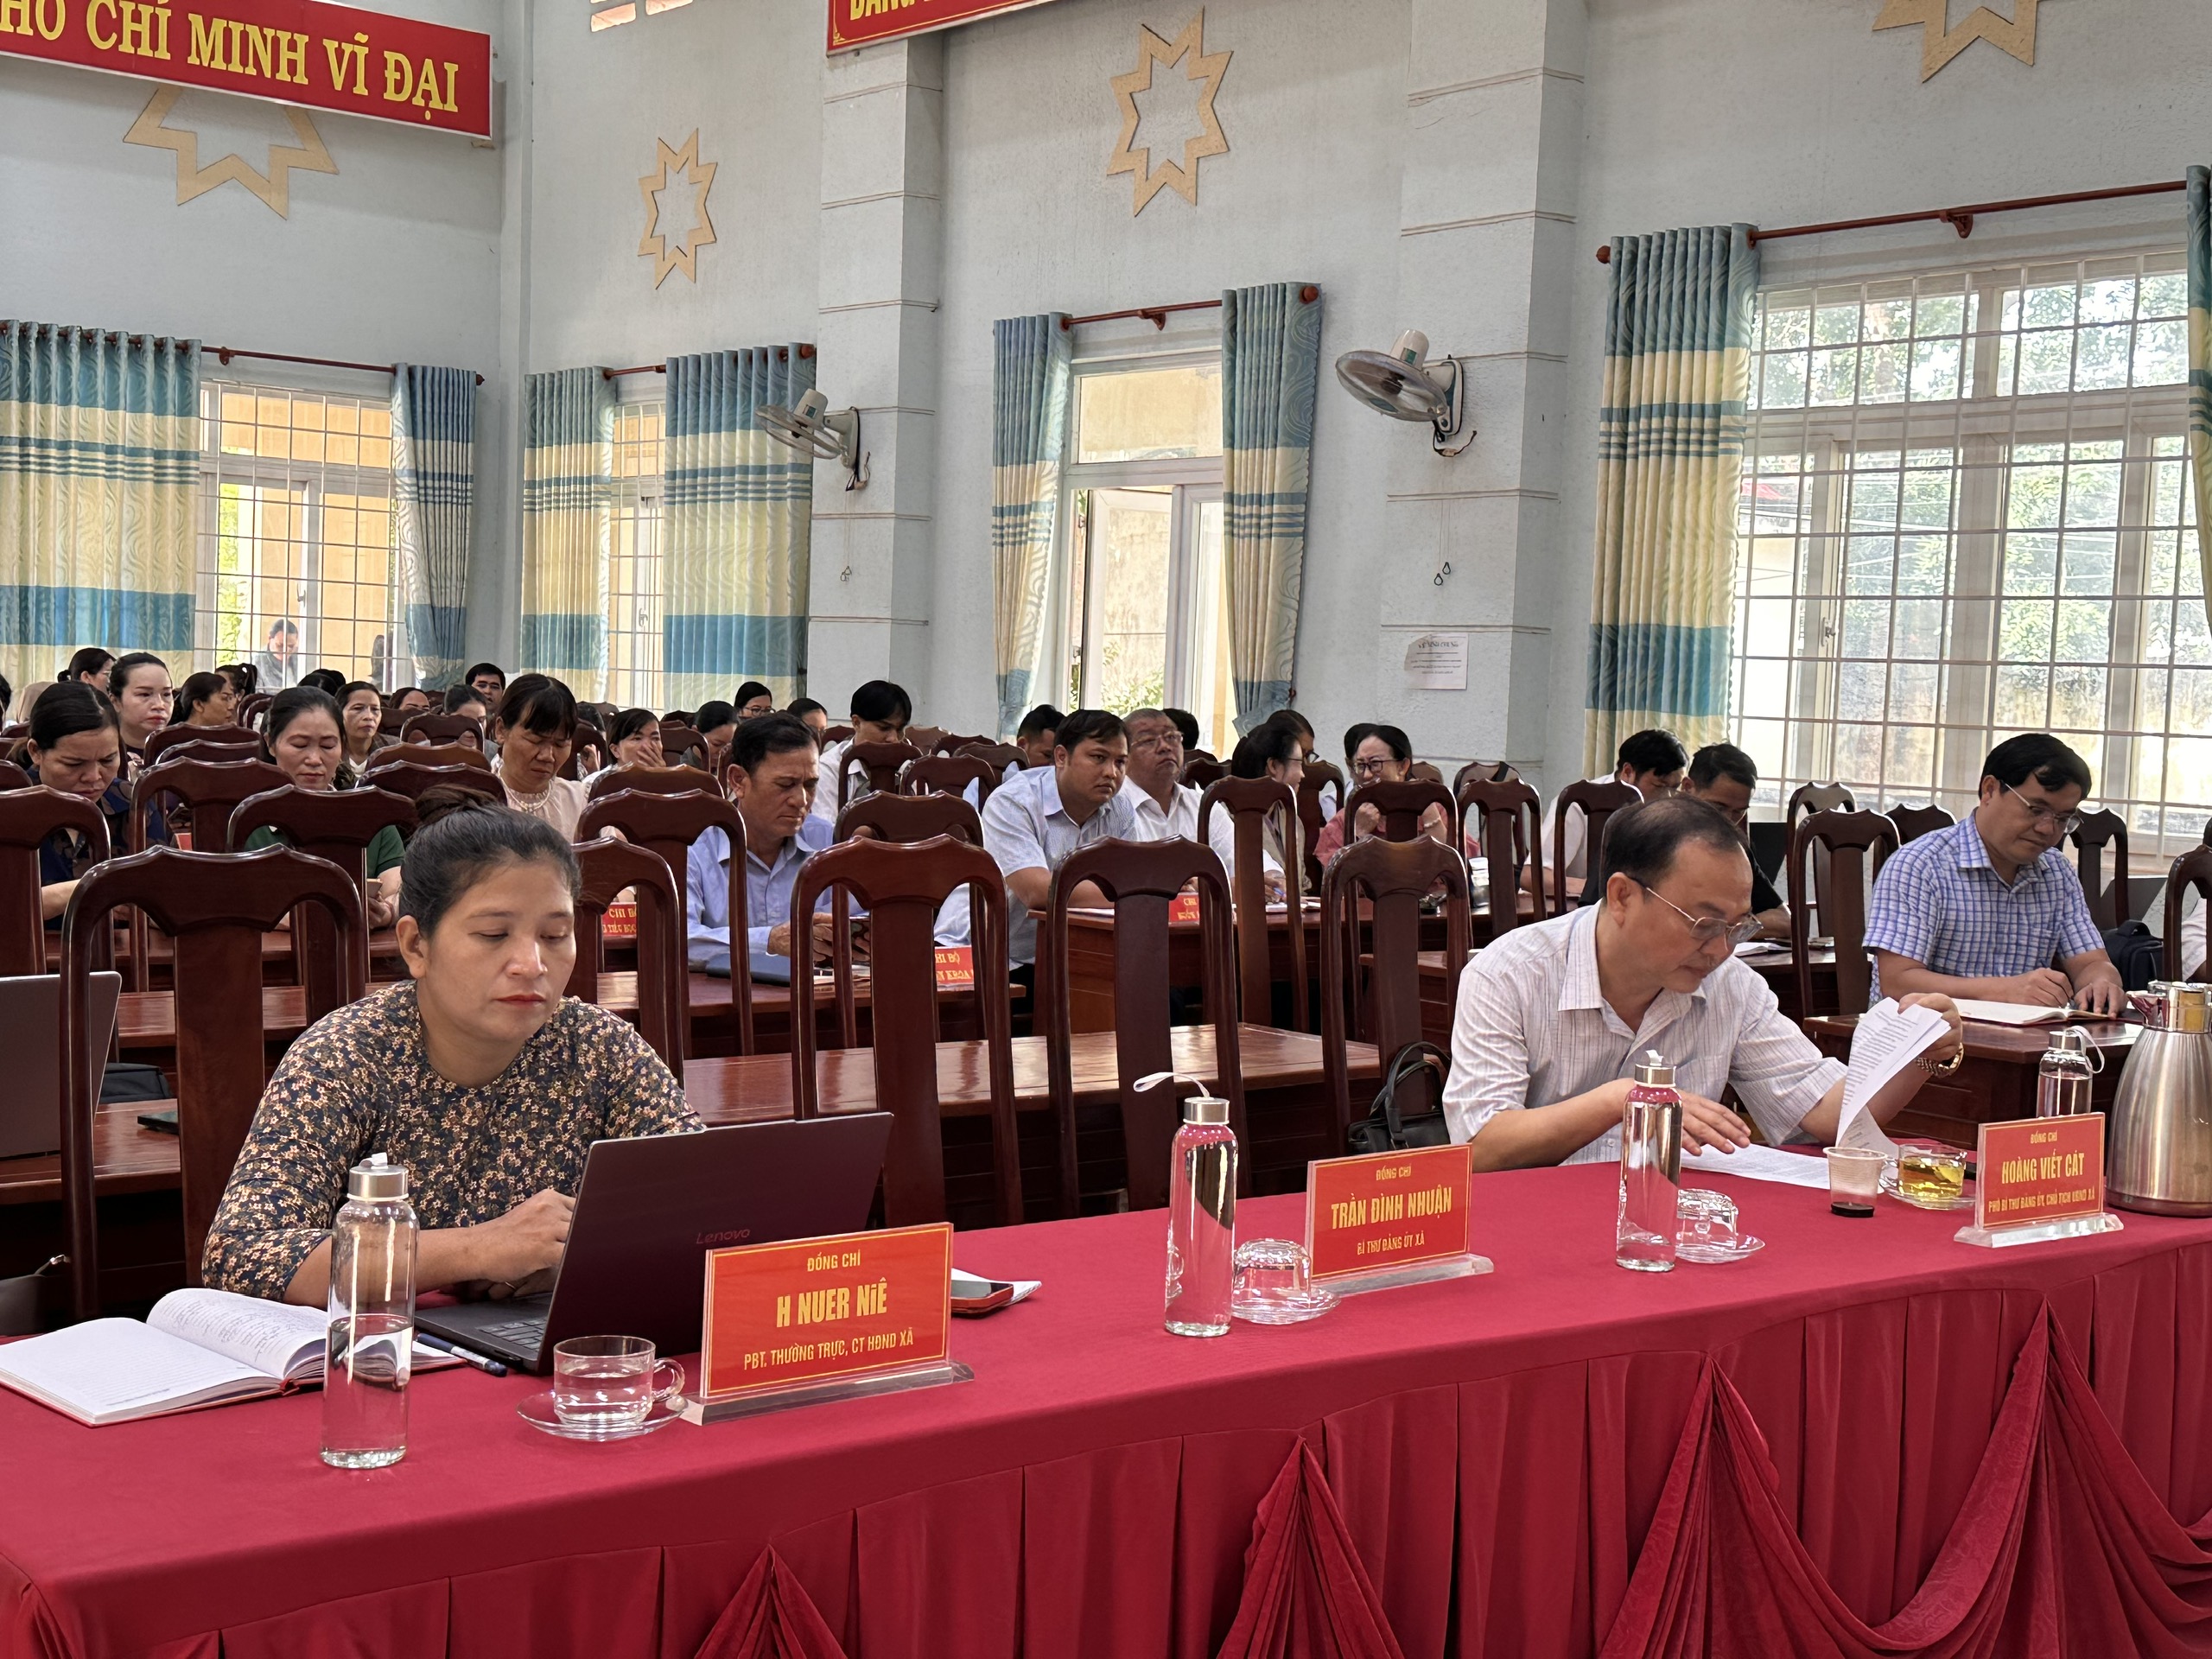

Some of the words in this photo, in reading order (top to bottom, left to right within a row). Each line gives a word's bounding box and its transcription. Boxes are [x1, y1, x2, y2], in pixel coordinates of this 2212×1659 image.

[187, 13, 308, 85] MINH
[323, 34, 369, 96] VĨ
[384, 50, 459, 121] ĐẠI
[2001, 1156, 2037, 1184] HOÀNG
[2040, 1148, 2063, 1179] VIẾT
[2065, 1150, 2085, 1177] CÁT
[1331, 1192, 1366, 1230] TRẦN
[1370, 1192, 1403, 1224] ĐÌNH
[1408, 1184, 1452, 1219] NHUẬN
[696, 1229, 751, 1244] Lenovo
[842, 1249, 861, 1268] CHÍ
[777, 1295, 791, 1327] H
[798, 1287, 850, 1325] NUER
[744, 1351, 767, 1370] PBT.
[771, 1338, 814, 1365] THƯỜNG
[817, 1338, 849, 1361] TRỰC,
[851, 1337, 865, 1354] CT
